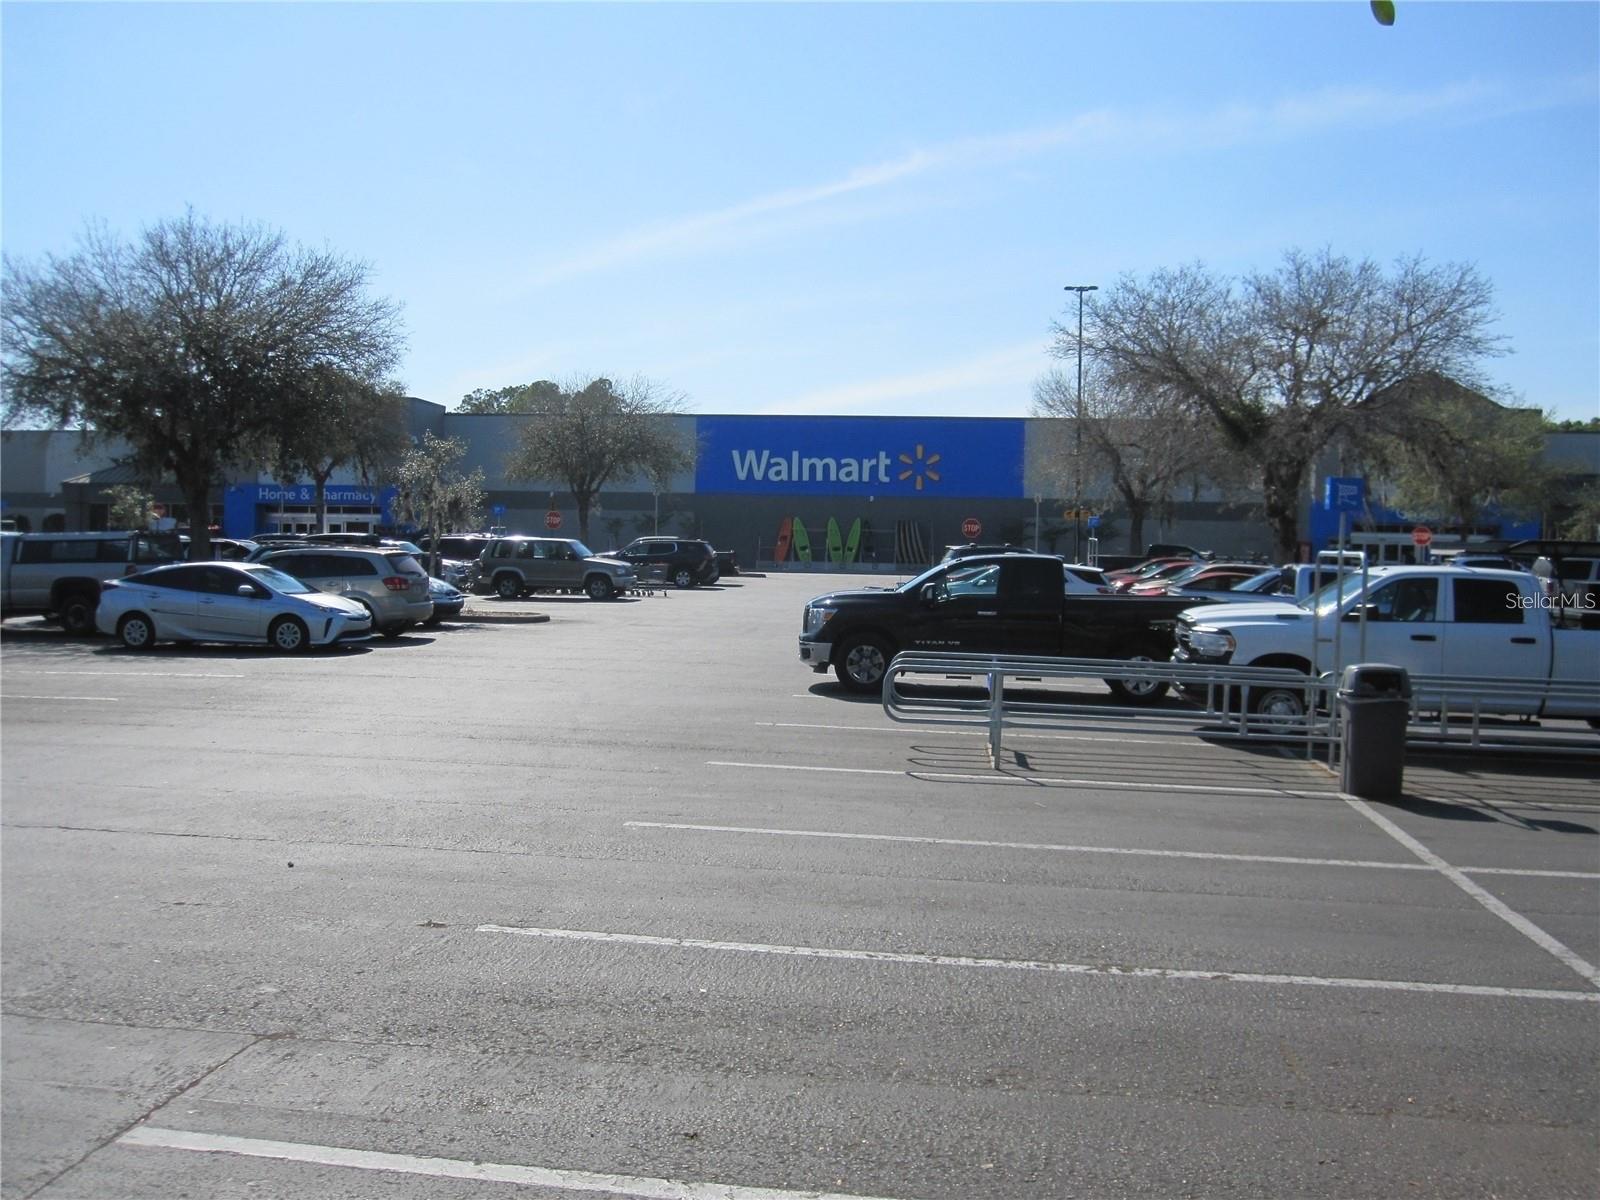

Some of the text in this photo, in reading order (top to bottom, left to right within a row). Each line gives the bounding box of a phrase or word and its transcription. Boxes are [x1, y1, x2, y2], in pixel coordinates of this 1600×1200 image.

[731, 449, 891, 482] Walmart
[258, 487, 376, 504] Home & harmacy
[544, 516, 560, 524] STOP
